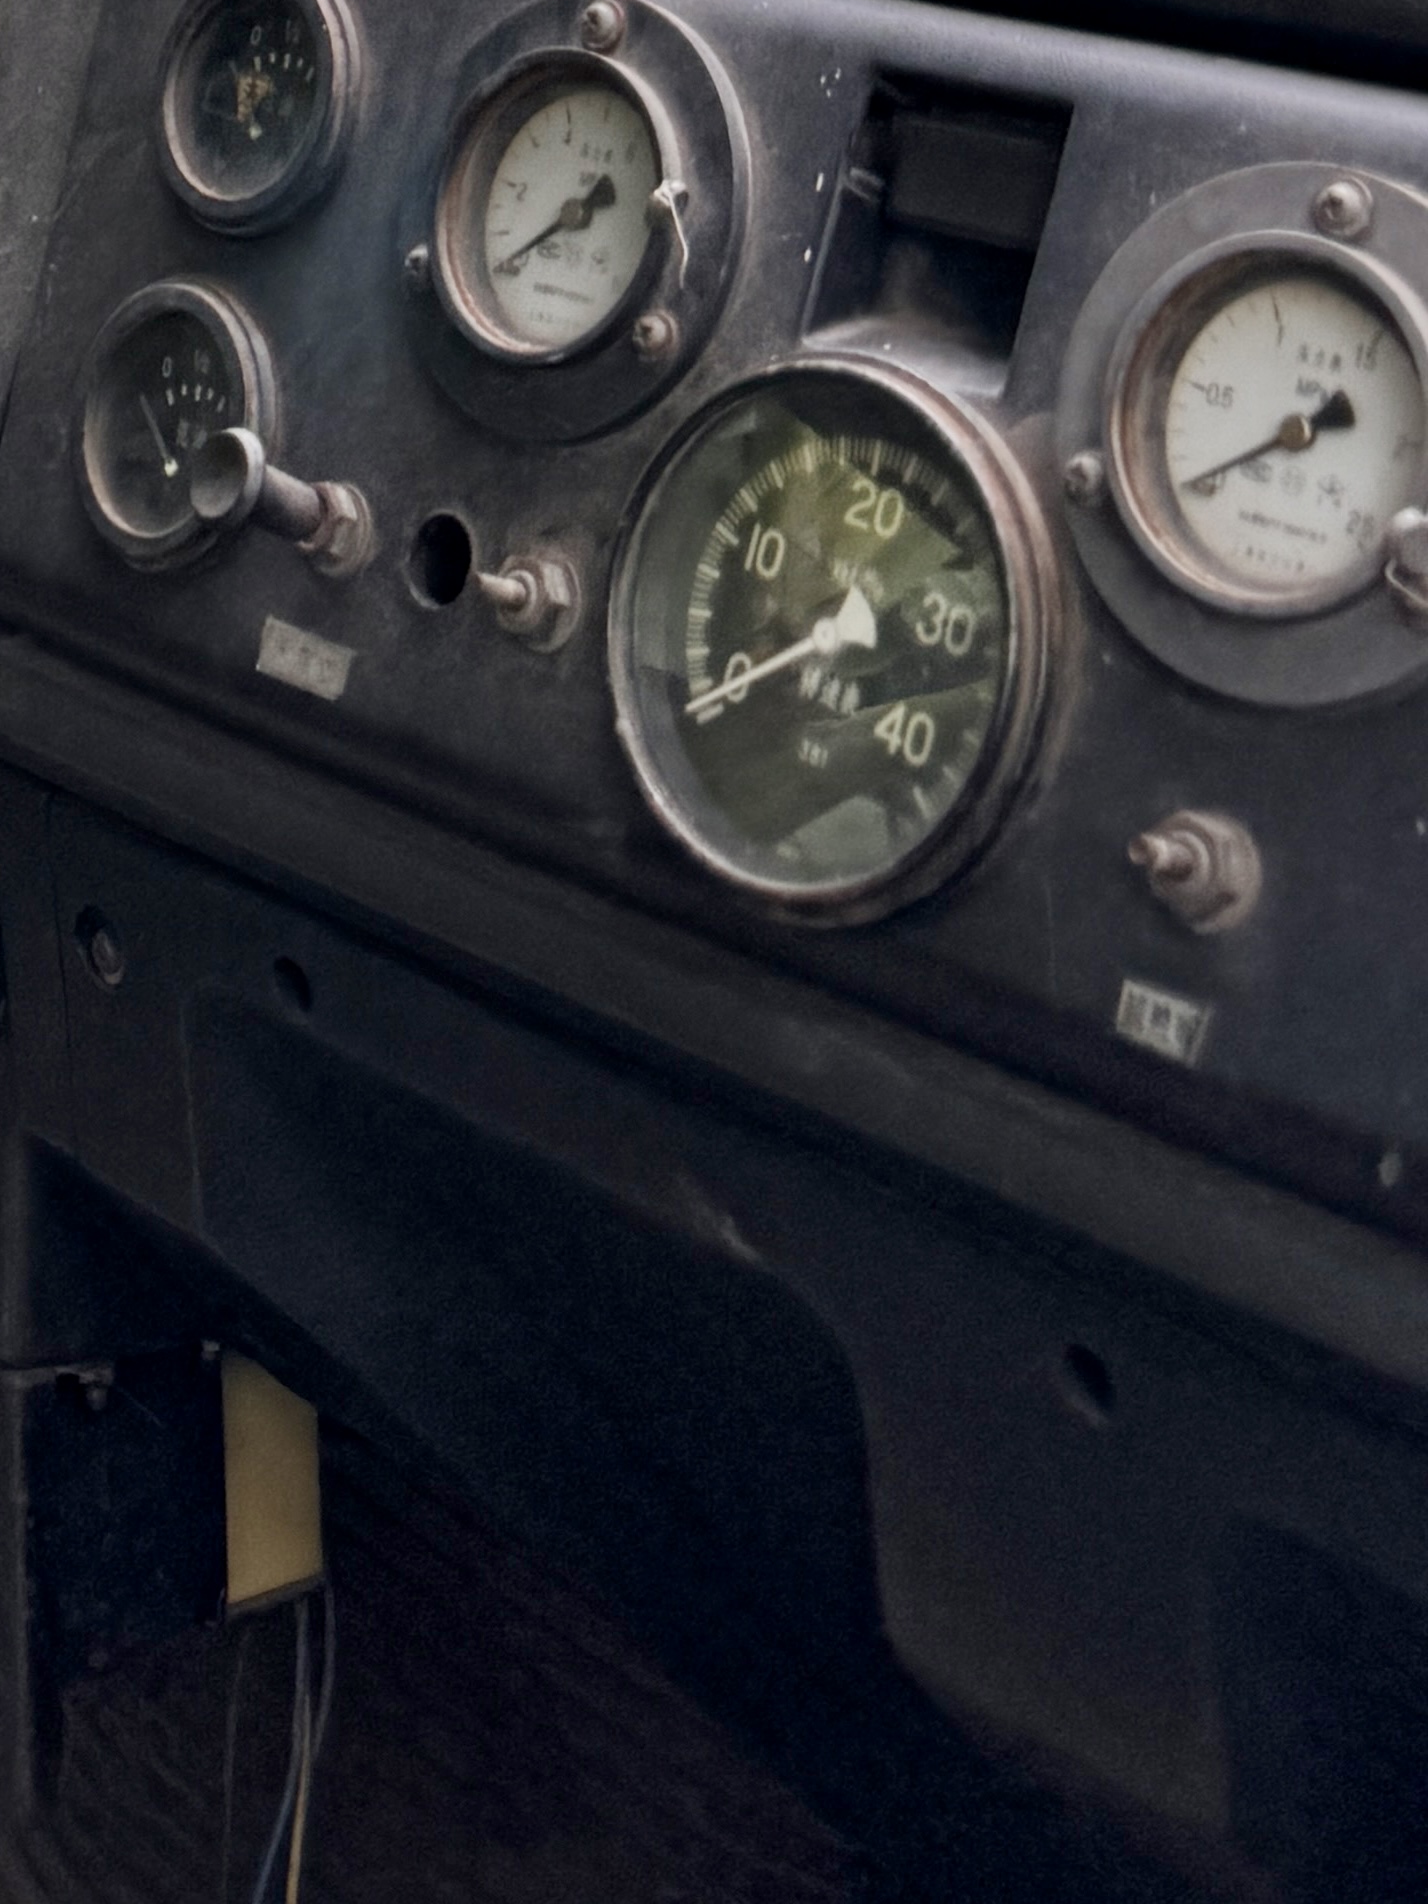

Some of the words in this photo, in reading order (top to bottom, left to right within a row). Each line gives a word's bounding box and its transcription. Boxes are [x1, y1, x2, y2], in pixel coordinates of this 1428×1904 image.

[843, 479, 905, 538] 20
[744, 522, 787, 582] 10
[914, 590, 976, 657] 30
[873, 701, 935, 768] 40
